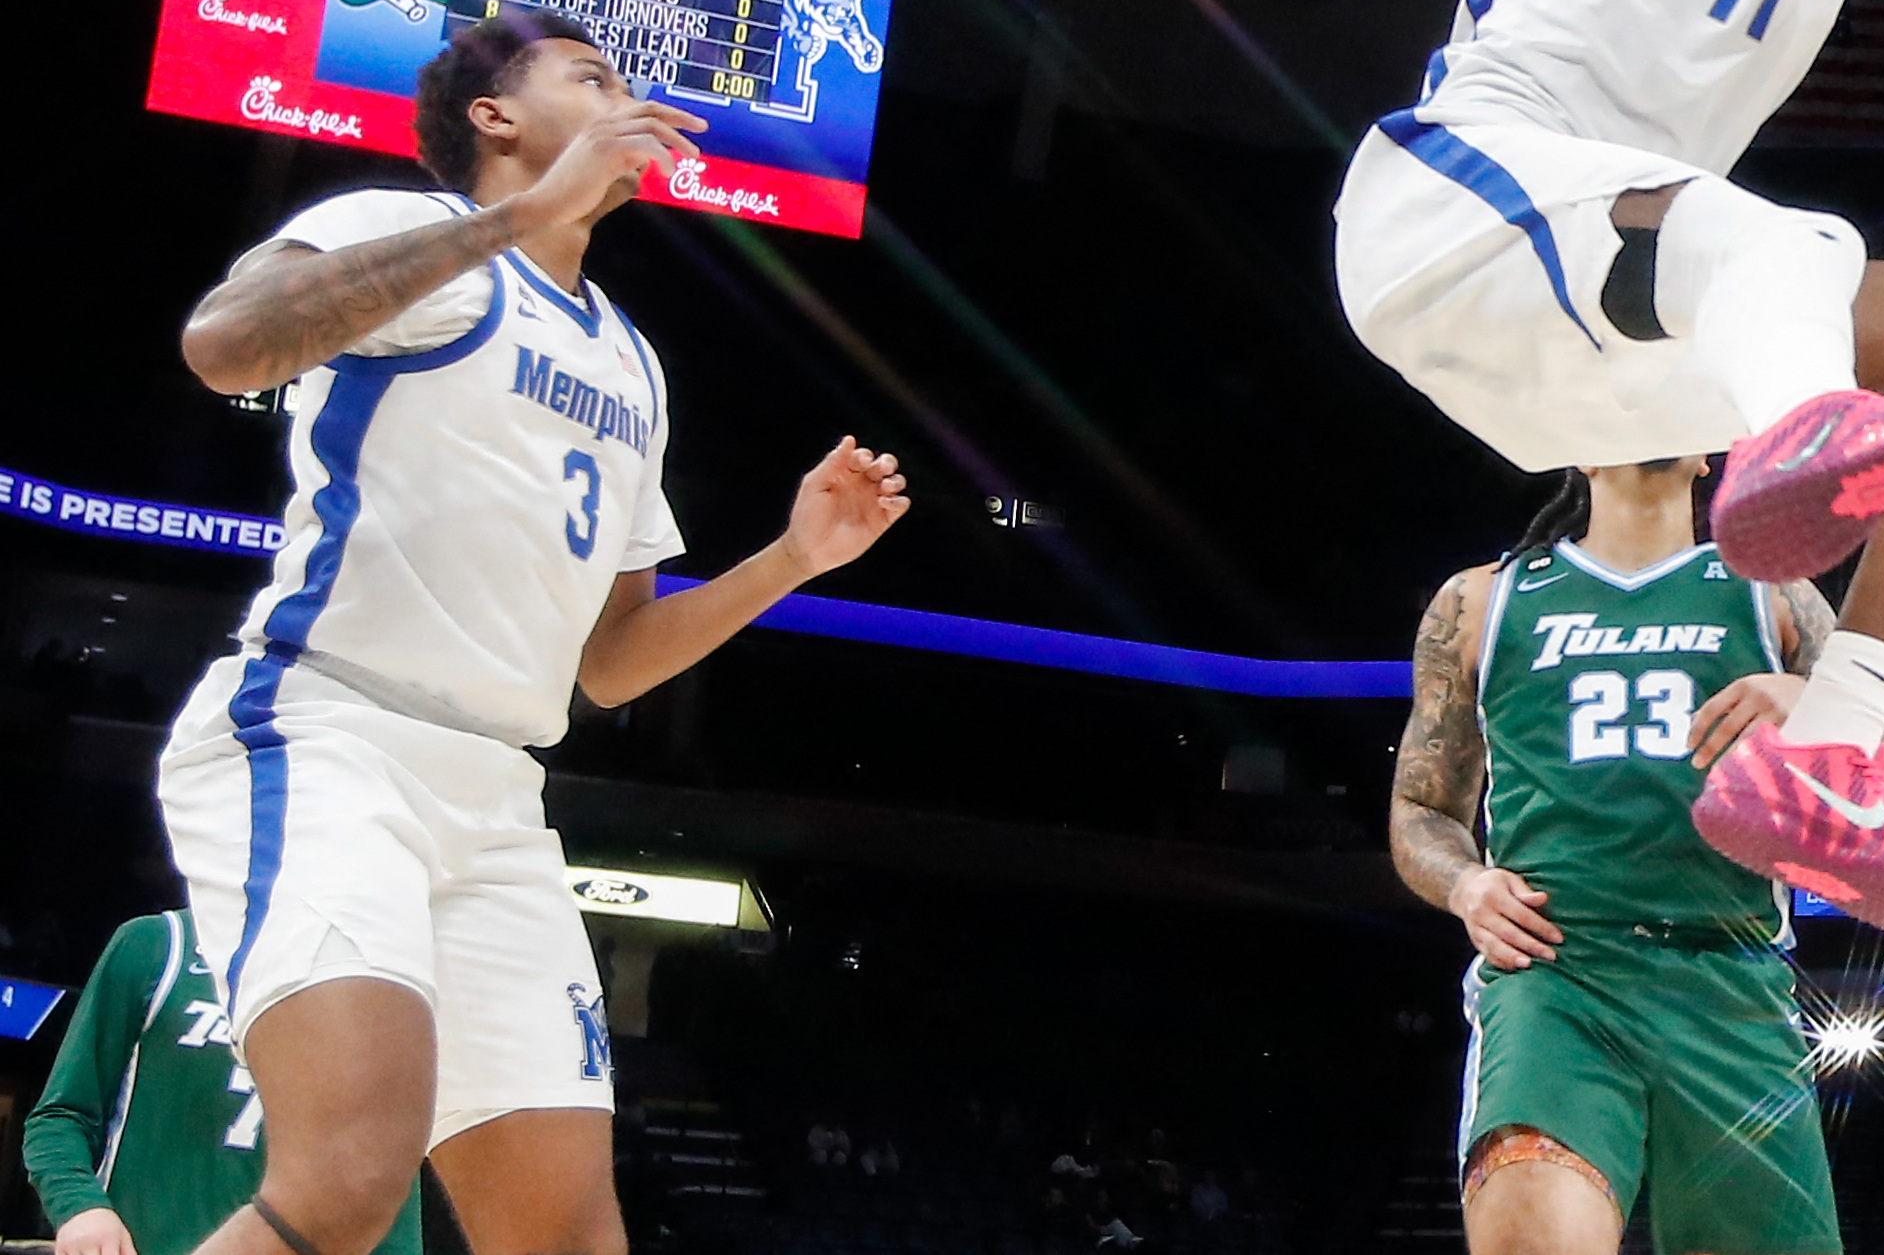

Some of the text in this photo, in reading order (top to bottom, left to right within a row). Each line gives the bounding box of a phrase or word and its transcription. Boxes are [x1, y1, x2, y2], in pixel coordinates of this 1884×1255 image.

[636, 28, 689, 60] LEAD
[730, 48, 744, 71] 0
[733, 22, 748, 45] 0
[625, 53, 679, 85] LEAD
[711, 73, 755, 99] 0:00
[508, 342, 650, 460] Memphis
[20, 481, 54, 514] IS
[60, 492, 290, 551] PRESENTED
[563, 448, 602, 563] 3
[1530, 611, 1728, 672] TULANE
[1568, 670, 1697, 765] 23
